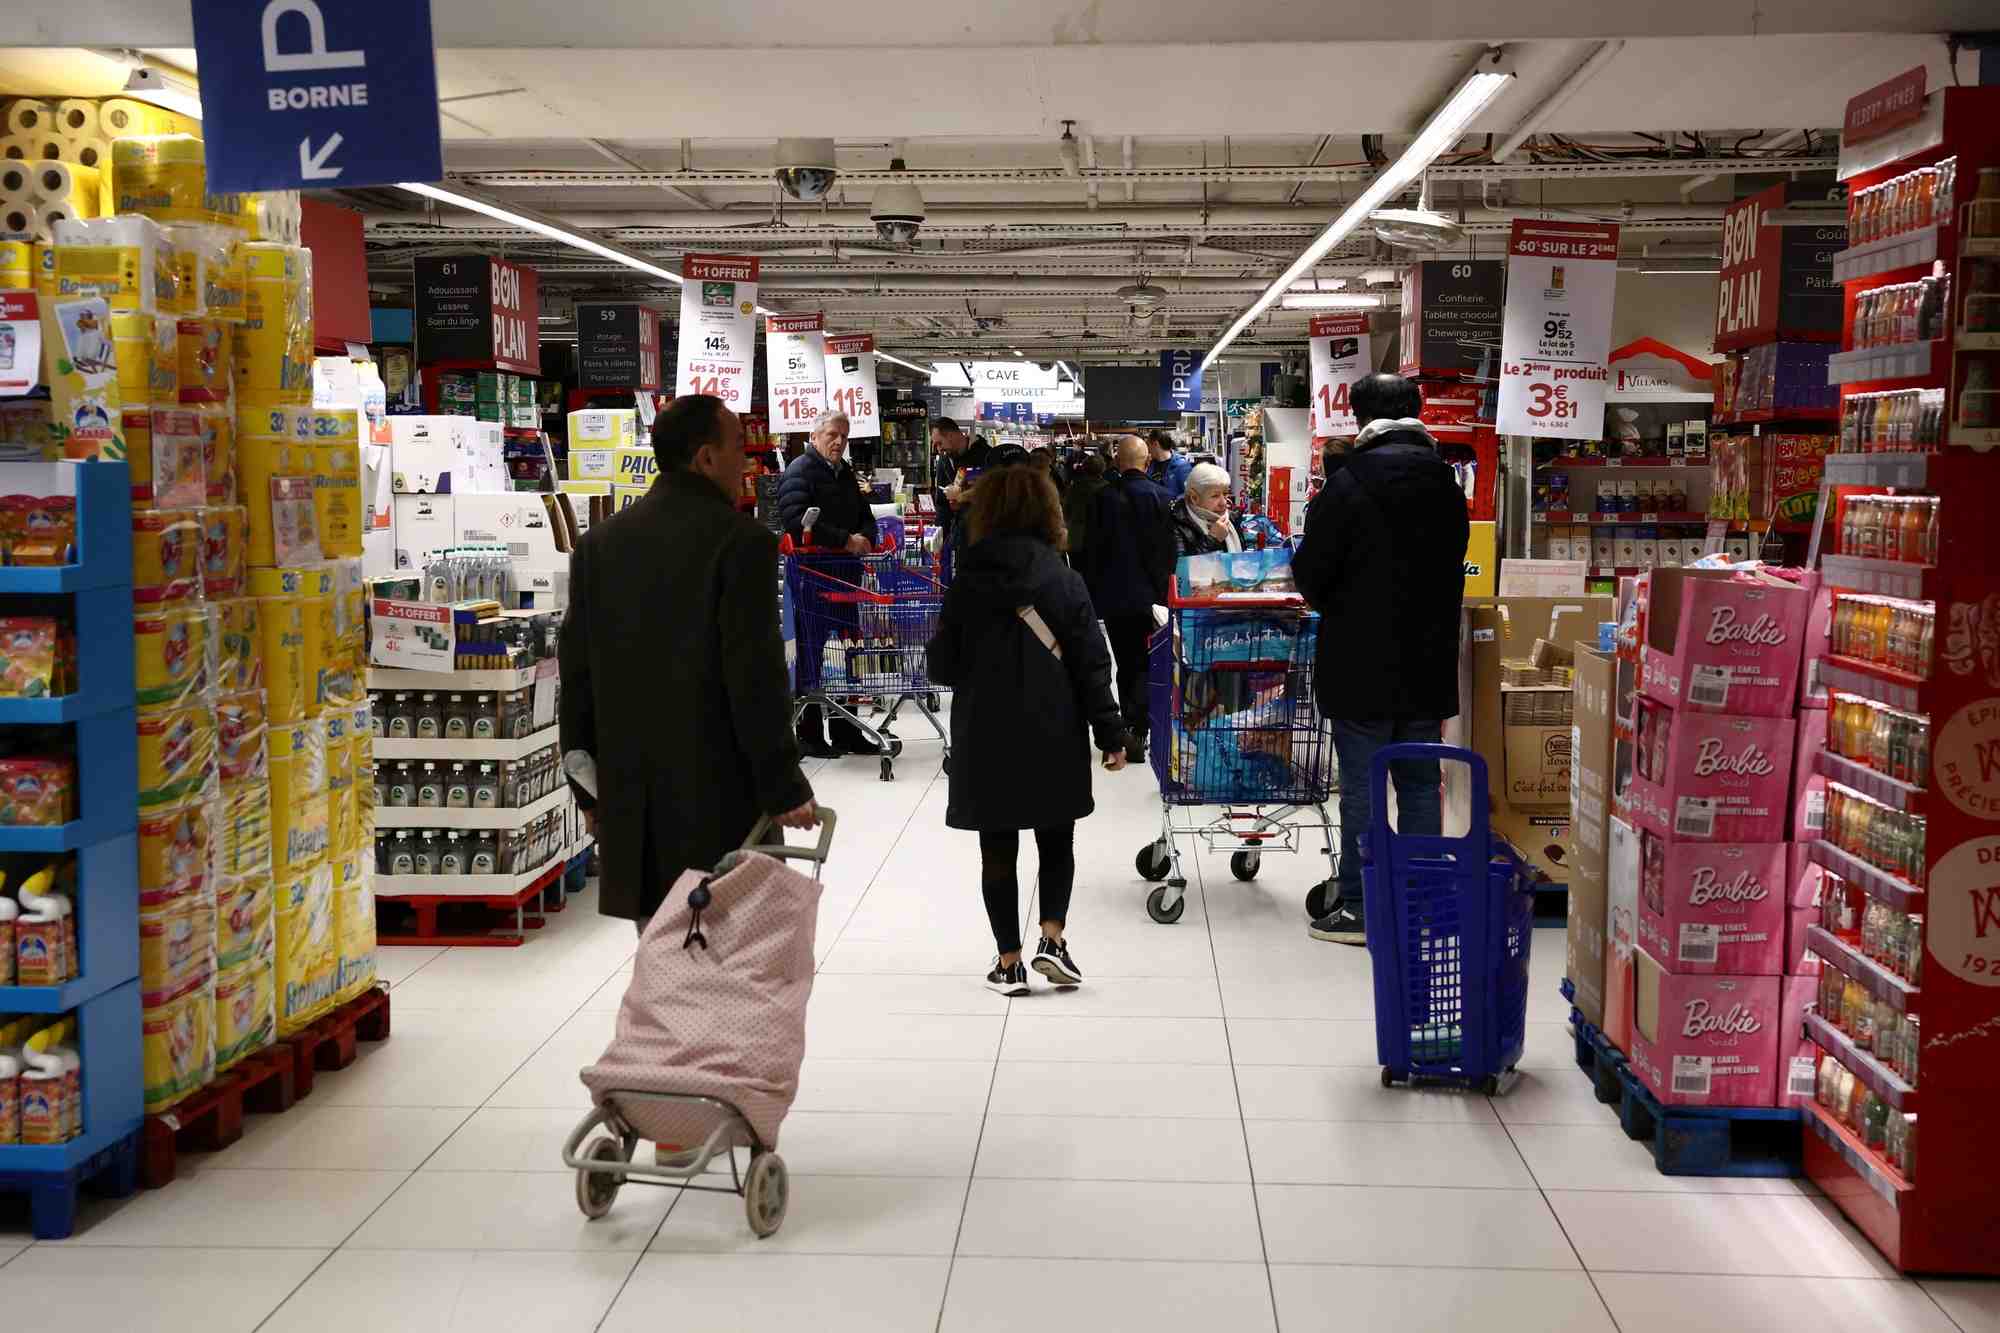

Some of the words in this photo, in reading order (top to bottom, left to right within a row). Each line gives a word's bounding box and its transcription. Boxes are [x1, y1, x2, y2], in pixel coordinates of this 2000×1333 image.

[267, 84, 369, 111] BORNE
[1722, 201, 1760, 269] BON
[1542, 242, 1568, 254] SUR
[1572, 244, 1587, 255] LE
[442, 263, 457, 275] 61
[711, 267, 751, 280] OFFERT
[1451, 265, 1472, 278] 60
[491, 262, 520, 311] BON
[1716, 270, 1761, 335] PLAN
[600, 310, 617, 321] 59
[1460, 311, 1498, 321] chocolat
[787, 320, 818, 331] OFFERT
[493, 313, 527, 361] PLAN
[689, 363, 707, 373] Les
[709, 363, 716, 373] 2
[718, 366, 742, 377] pour
[986, 369, 1020, 381] CAVE
[1503, 362, 1520, 375] Le
[1523, 362, 1551, 378] 2ème
[1554, 363, 1608, 380] produit
[774, 387, 789, 396] Les
[800, 387, 821, 396] pour
[314, 416, 338, 436] 32
[620, 455, 657, 474] PAIC
[405, 608, 442, 621] OFFERT
[1705, 606, 1787, 646] Barbie
[1695, 737, 1774, 776] Barbie
[1688, 866, 1769, 905] Barbie
[1681, 998, 1761, 1038] Barbie
